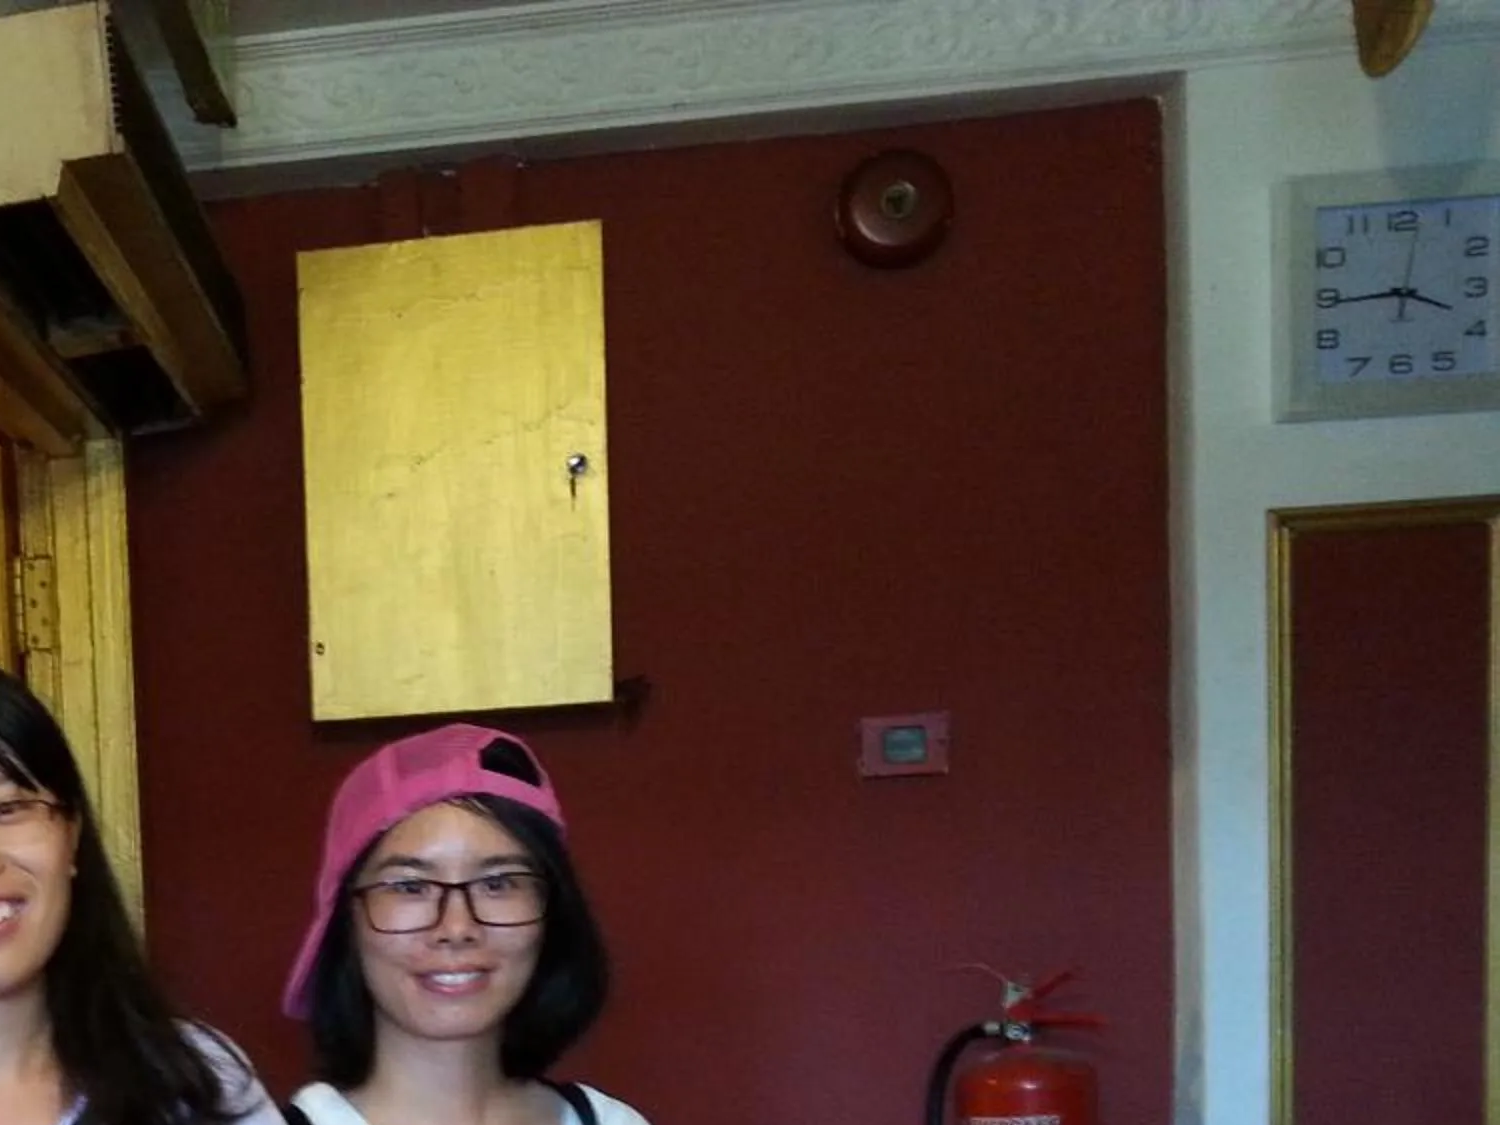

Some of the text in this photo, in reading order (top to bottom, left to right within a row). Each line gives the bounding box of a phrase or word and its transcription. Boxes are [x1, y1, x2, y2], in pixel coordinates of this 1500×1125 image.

[1347, 213, 1369, 235] 11
[1387, 210, 1419, 233] 12
[1316, 246, 1346, 269] 10
[1464, 235, 1490, 258] 2
[1316, 288, 1340, 308] 9
[1464, 276, 1488, 298] 3
[1316, 329, 1340, 350] 8
[1463, 320, 1487, 338] 4
[1345, 356, 1372, 377] 7
[1388, 353, 1414, 375] 6
[1431, 351, 1457, 371] 5
